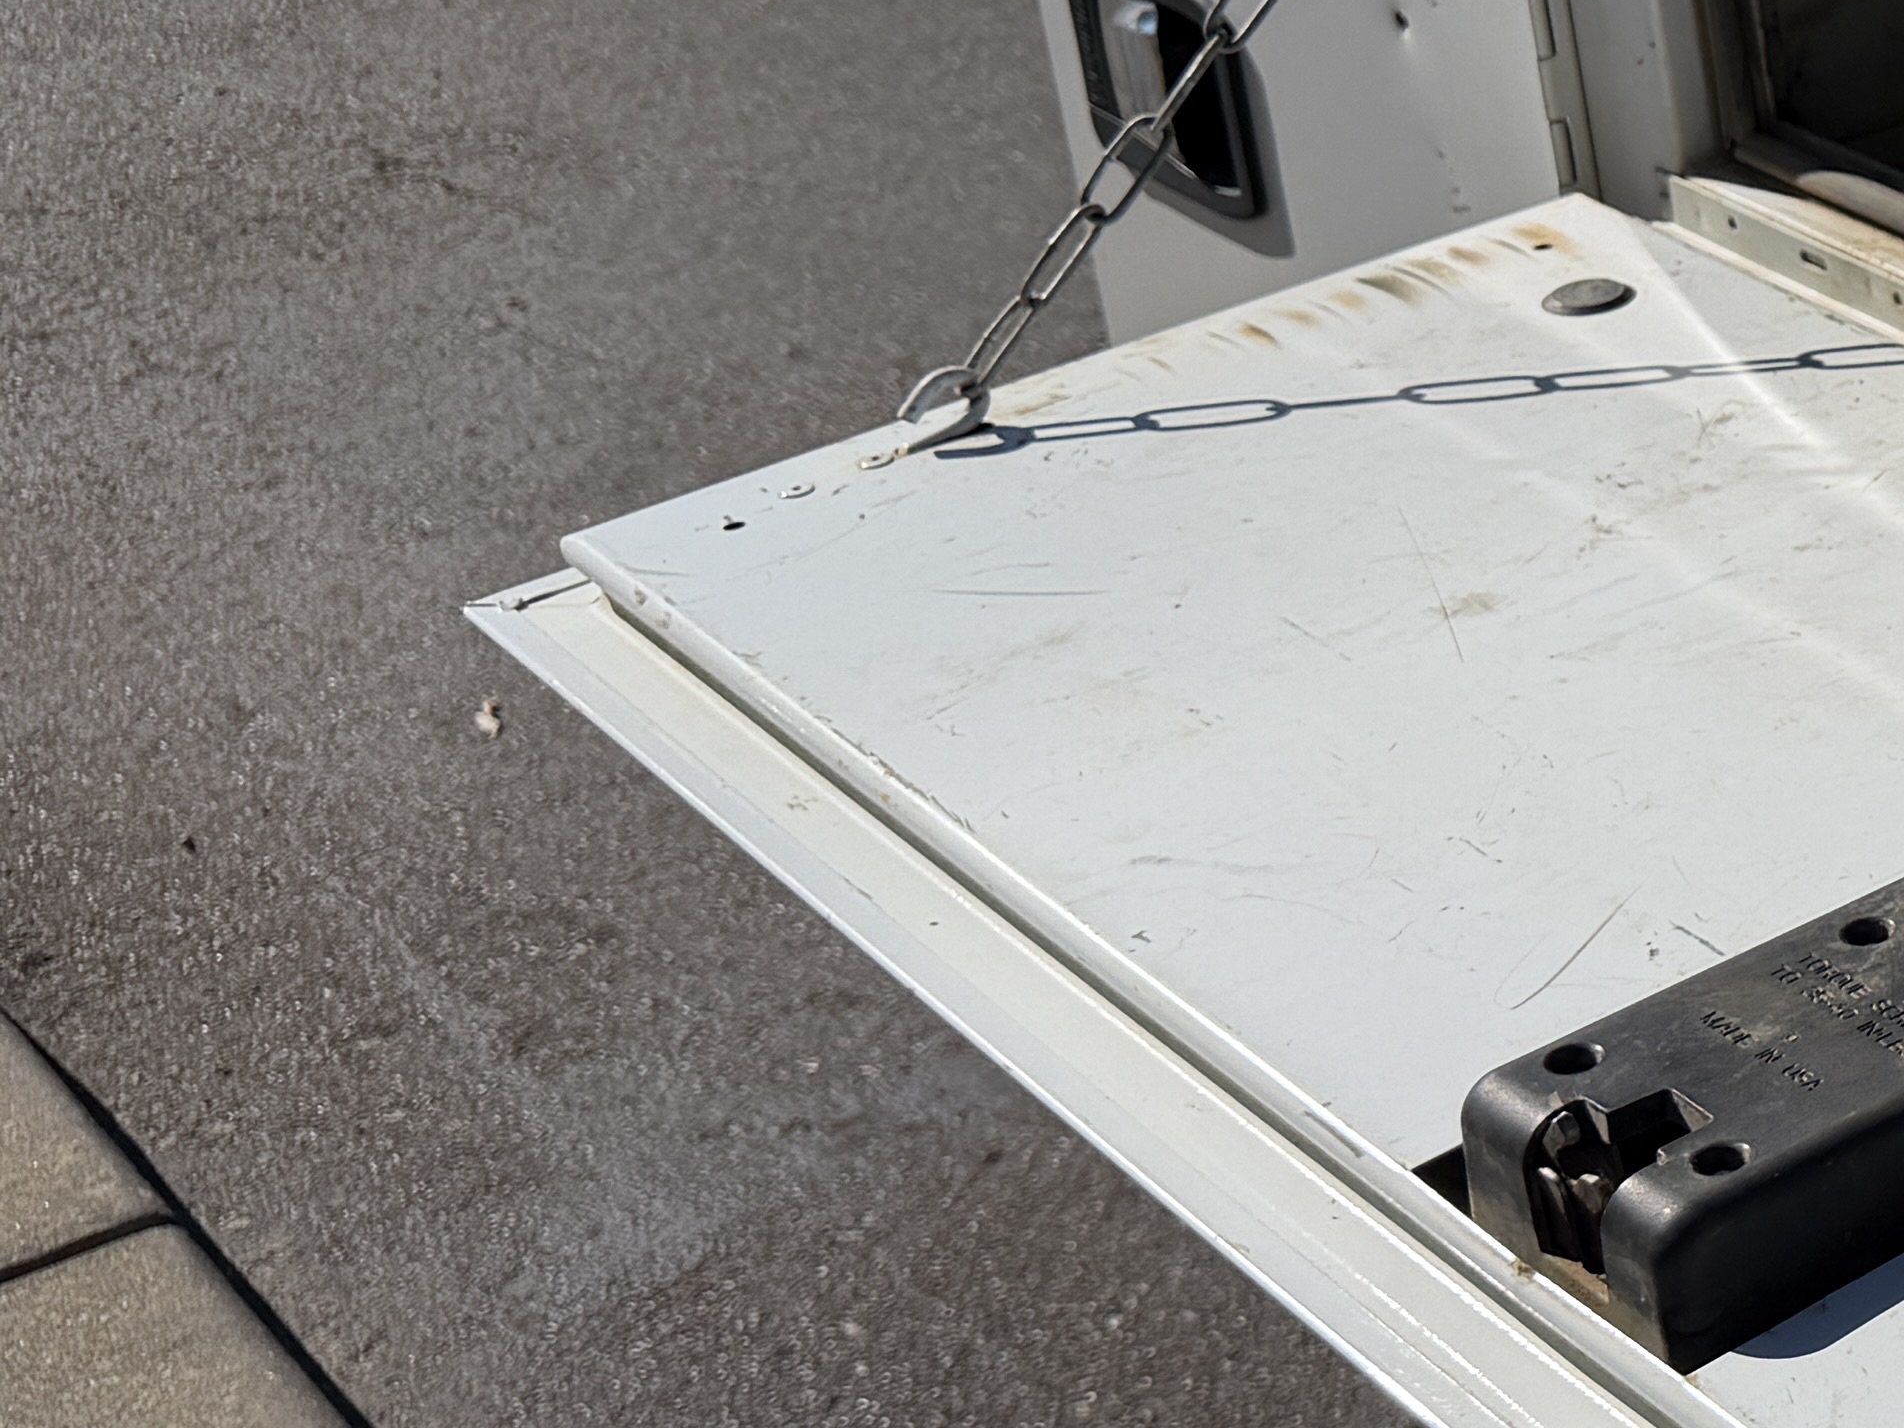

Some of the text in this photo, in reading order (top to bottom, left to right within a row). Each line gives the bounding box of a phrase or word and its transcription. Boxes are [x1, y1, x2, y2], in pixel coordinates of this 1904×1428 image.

[1771, 963, 1802, 984] TO
[1799, 952, 1872, 999] TORQUE
[1700, 1010, 1824, 1091] MADE IN USA
